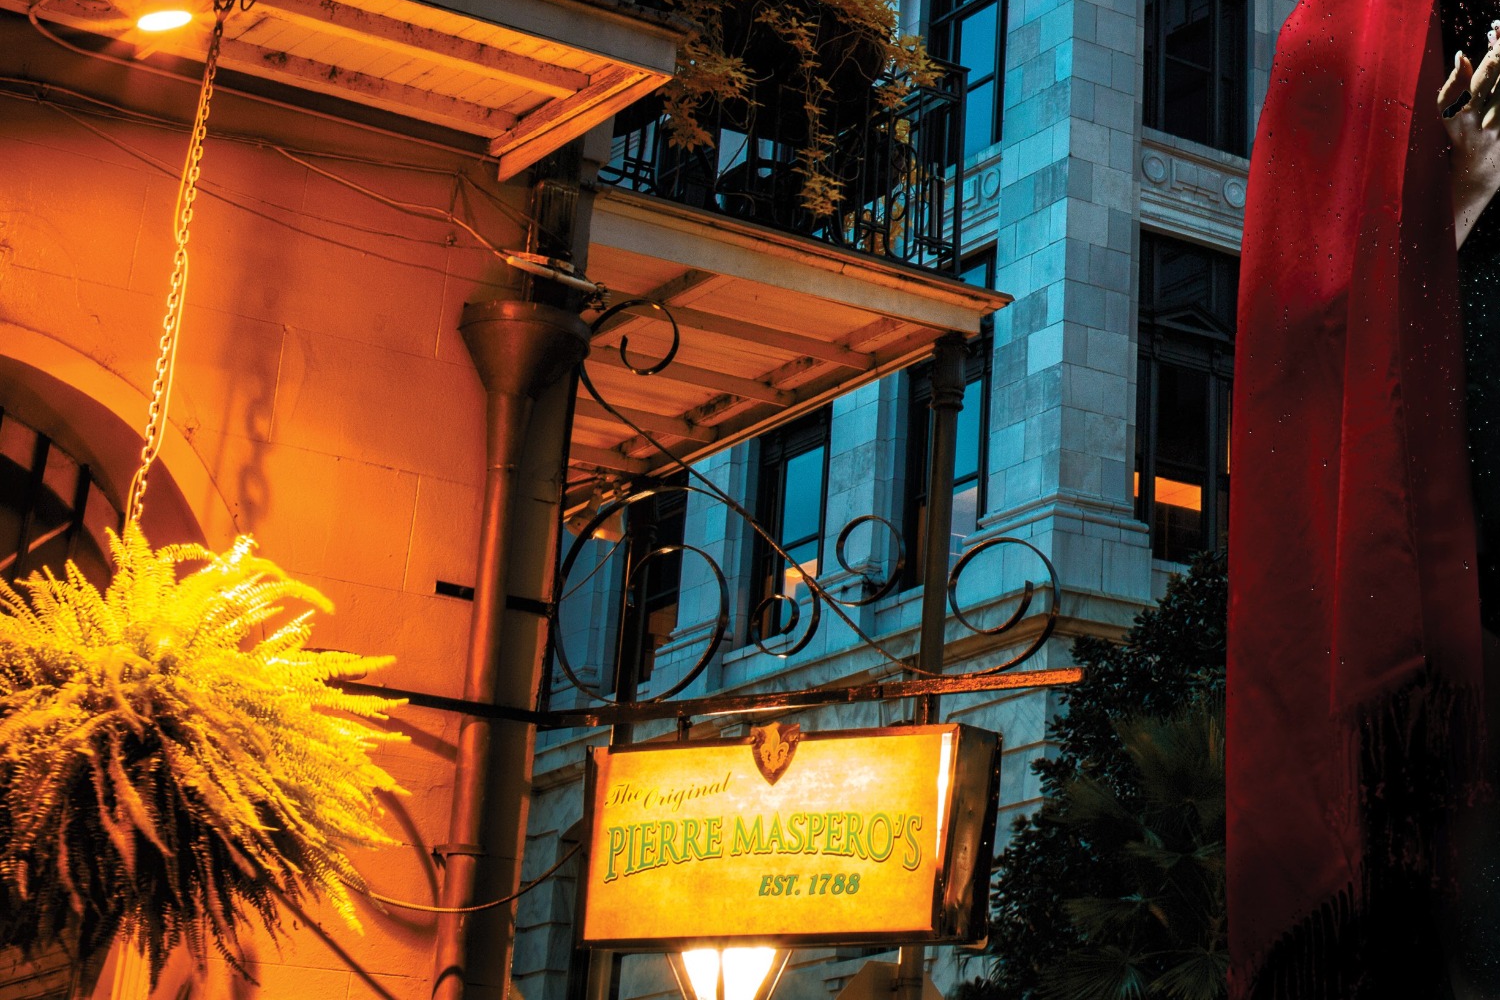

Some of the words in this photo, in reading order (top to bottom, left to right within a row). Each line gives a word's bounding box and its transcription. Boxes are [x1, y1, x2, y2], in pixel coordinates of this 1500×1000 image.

[603, 816, 724, 883] PIERRE
[730, 811, 922, 871] MASPERO'S
[758, 874, 800, 897] EST.
[809, 873, 861, 896] 1788
